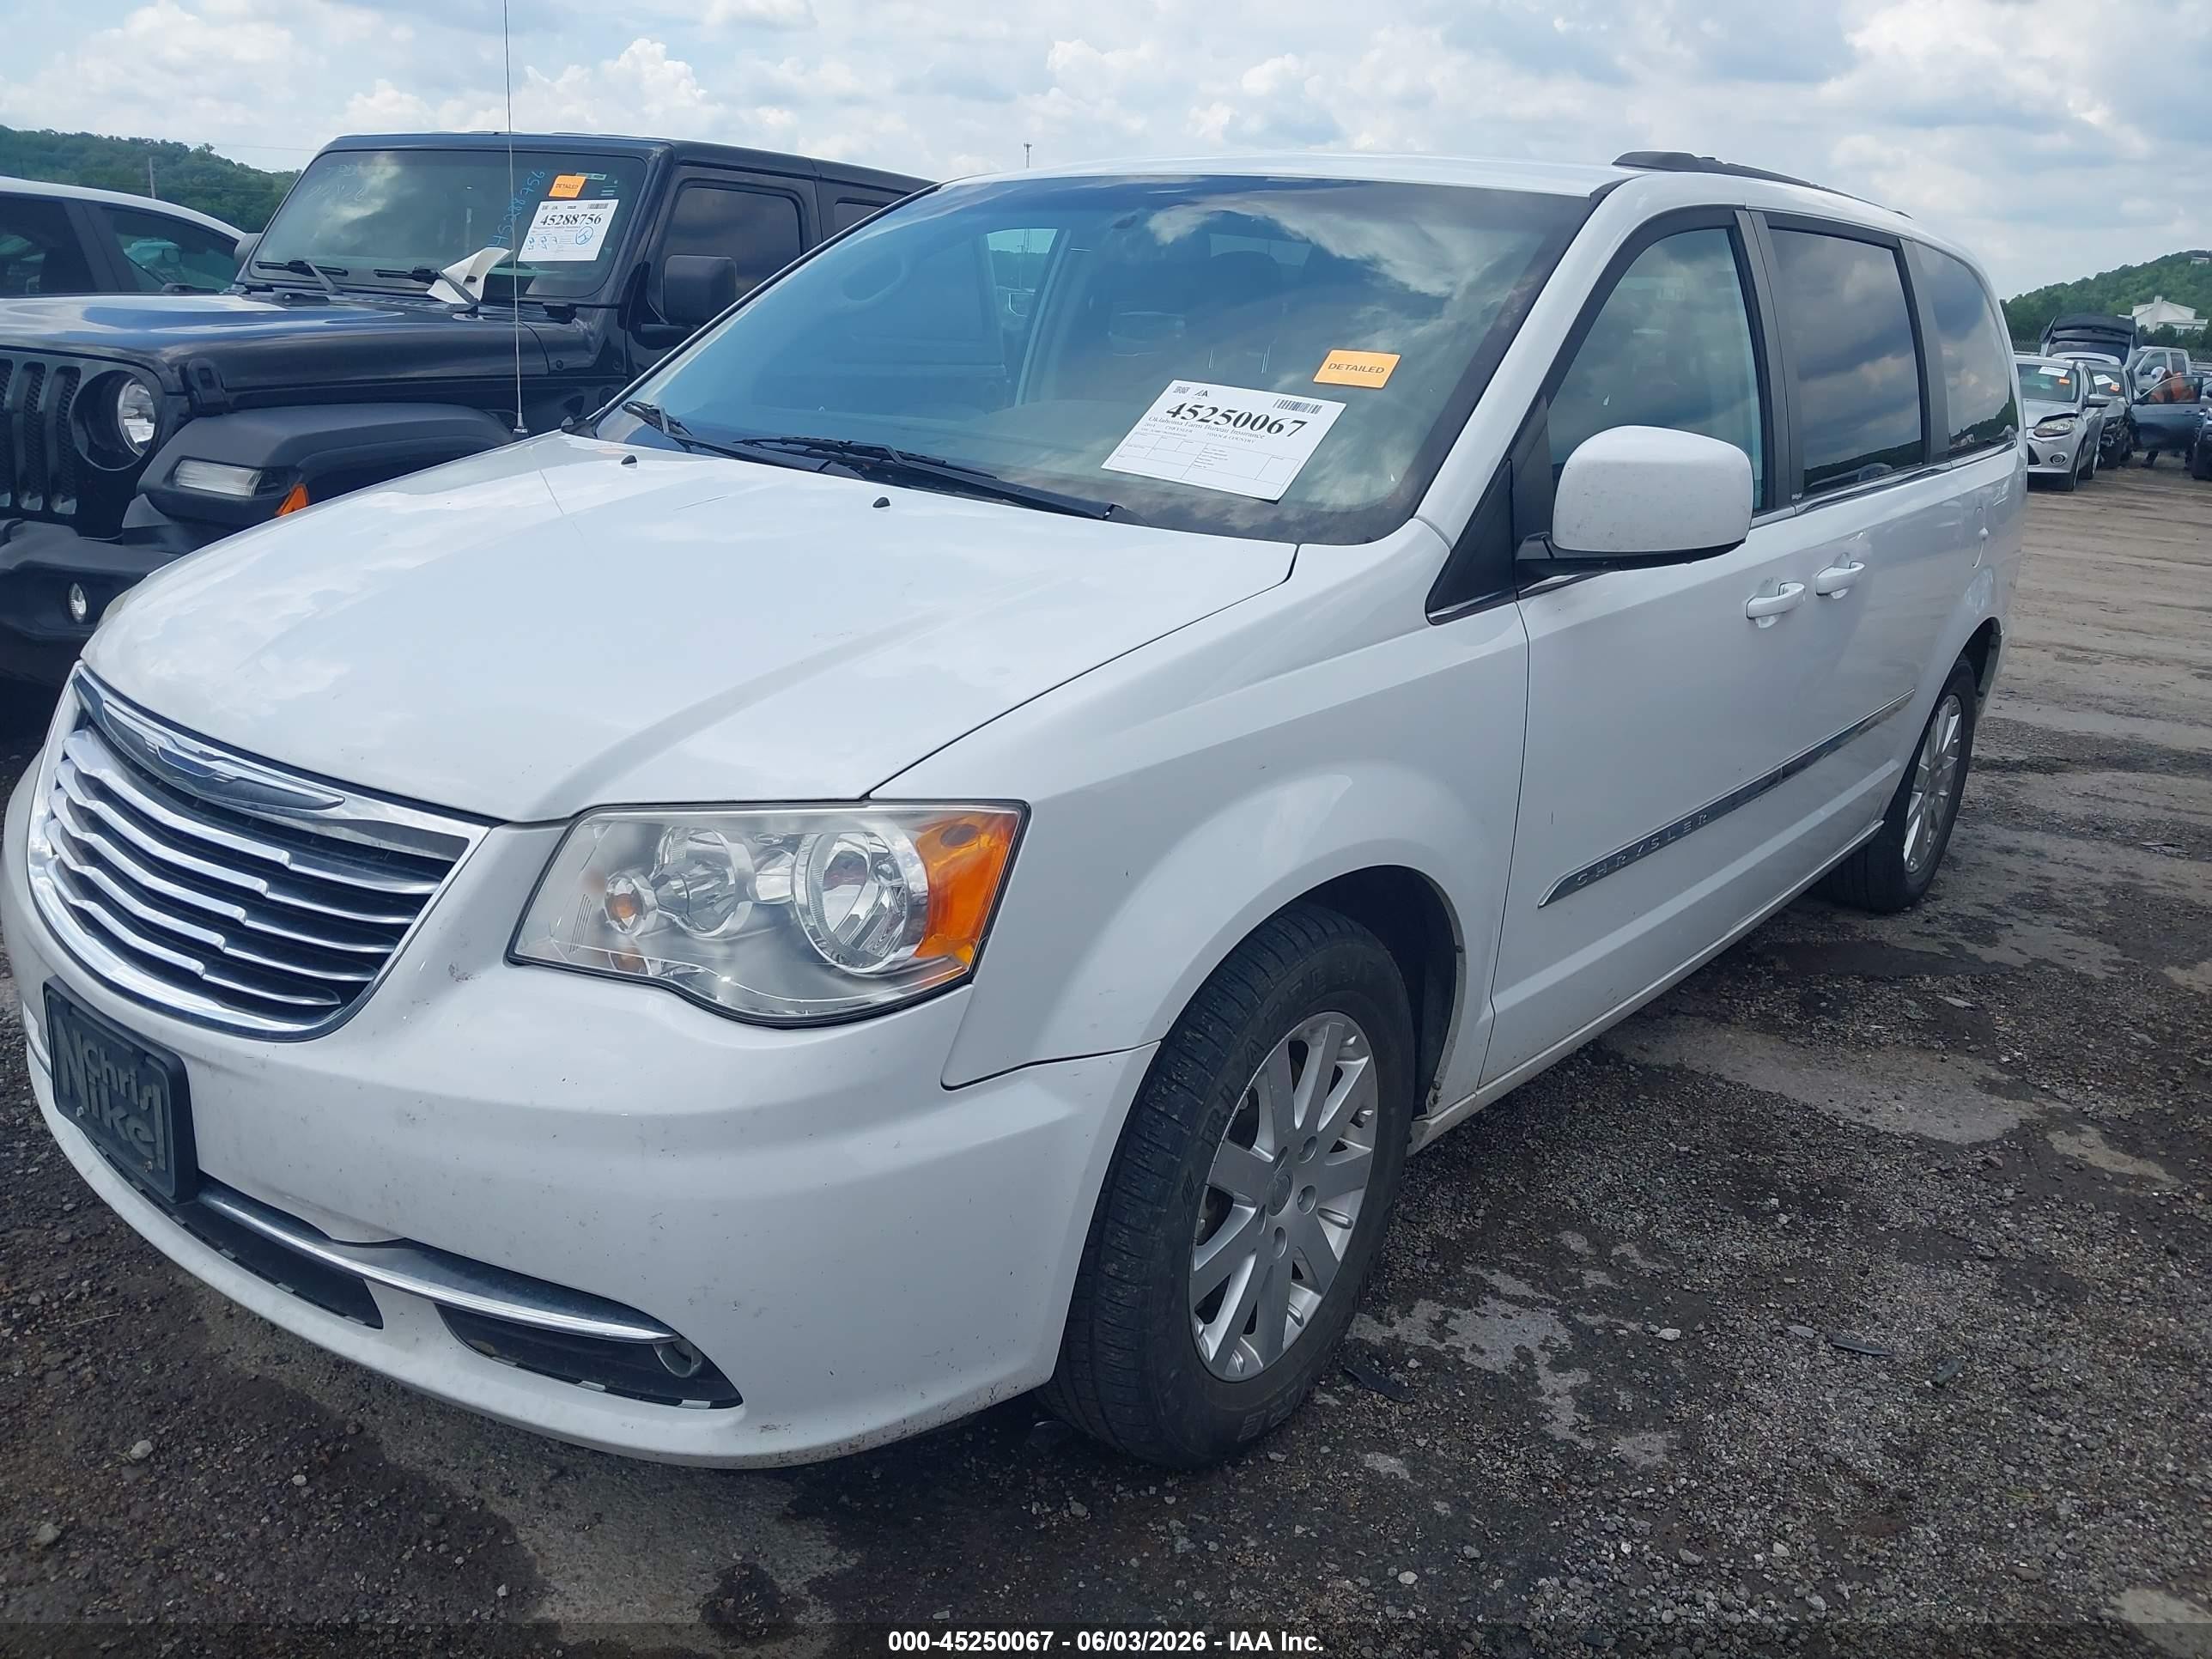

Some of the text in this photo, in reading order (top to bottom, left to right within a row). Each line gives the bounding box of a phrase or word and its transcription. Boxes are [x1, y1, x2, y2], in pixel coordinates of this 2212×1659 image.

[540, 214, 602, 226] 45288756
[1327, 362, 1385, 374] DETAILED
[1148, 416, 1266, 440] Oklahoma Farm Bureau Insurance
[1166, 401, 1308, 437] 45250067
[1577, 811, 1709, 887] CHRYSLER
[81, 1038, 153, 1111] Chris
